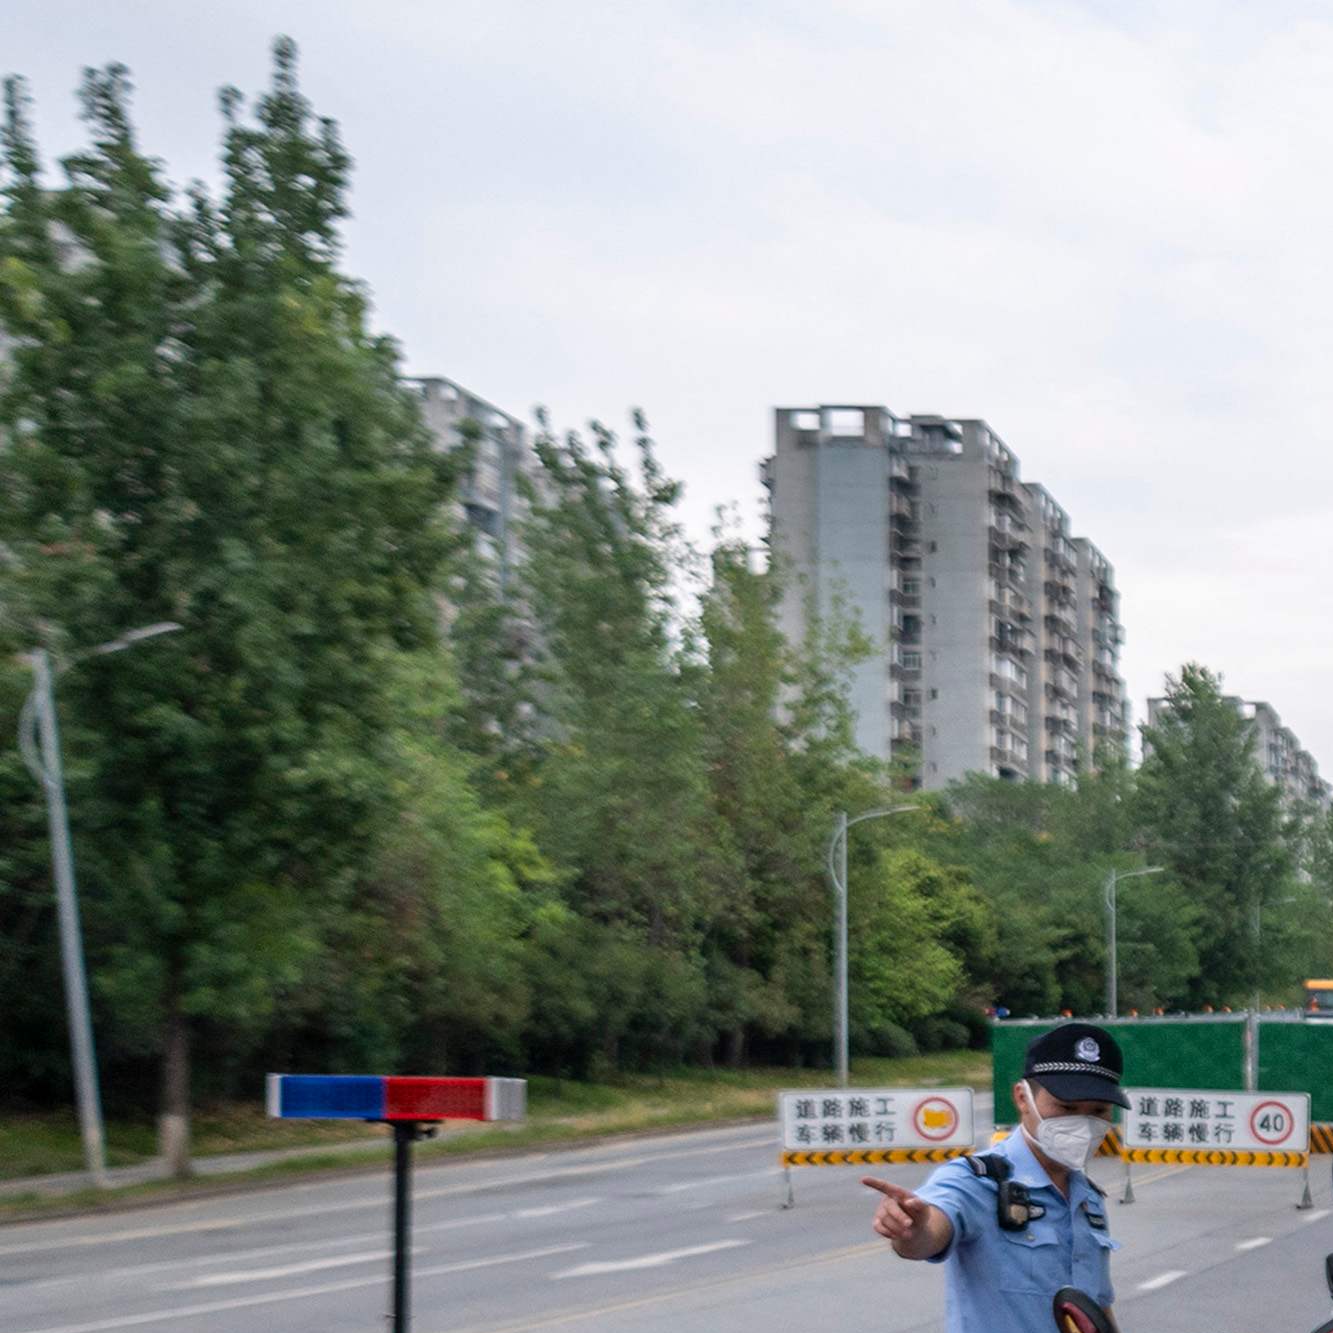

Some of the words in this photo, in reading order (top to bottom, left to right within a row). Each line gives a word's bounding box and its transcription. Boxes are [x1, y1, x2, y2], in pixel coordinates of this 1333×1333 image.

[795, 1097, 897, 1120] 道路施工
[1137, 1096, 1235, 1120] 道路施工
[795, 1121, 897, 1145] 车辆慢行
[1137, 1121, 1235, 1144] 车辆慢行
[1258, 1113, 1286, 1133] 40
